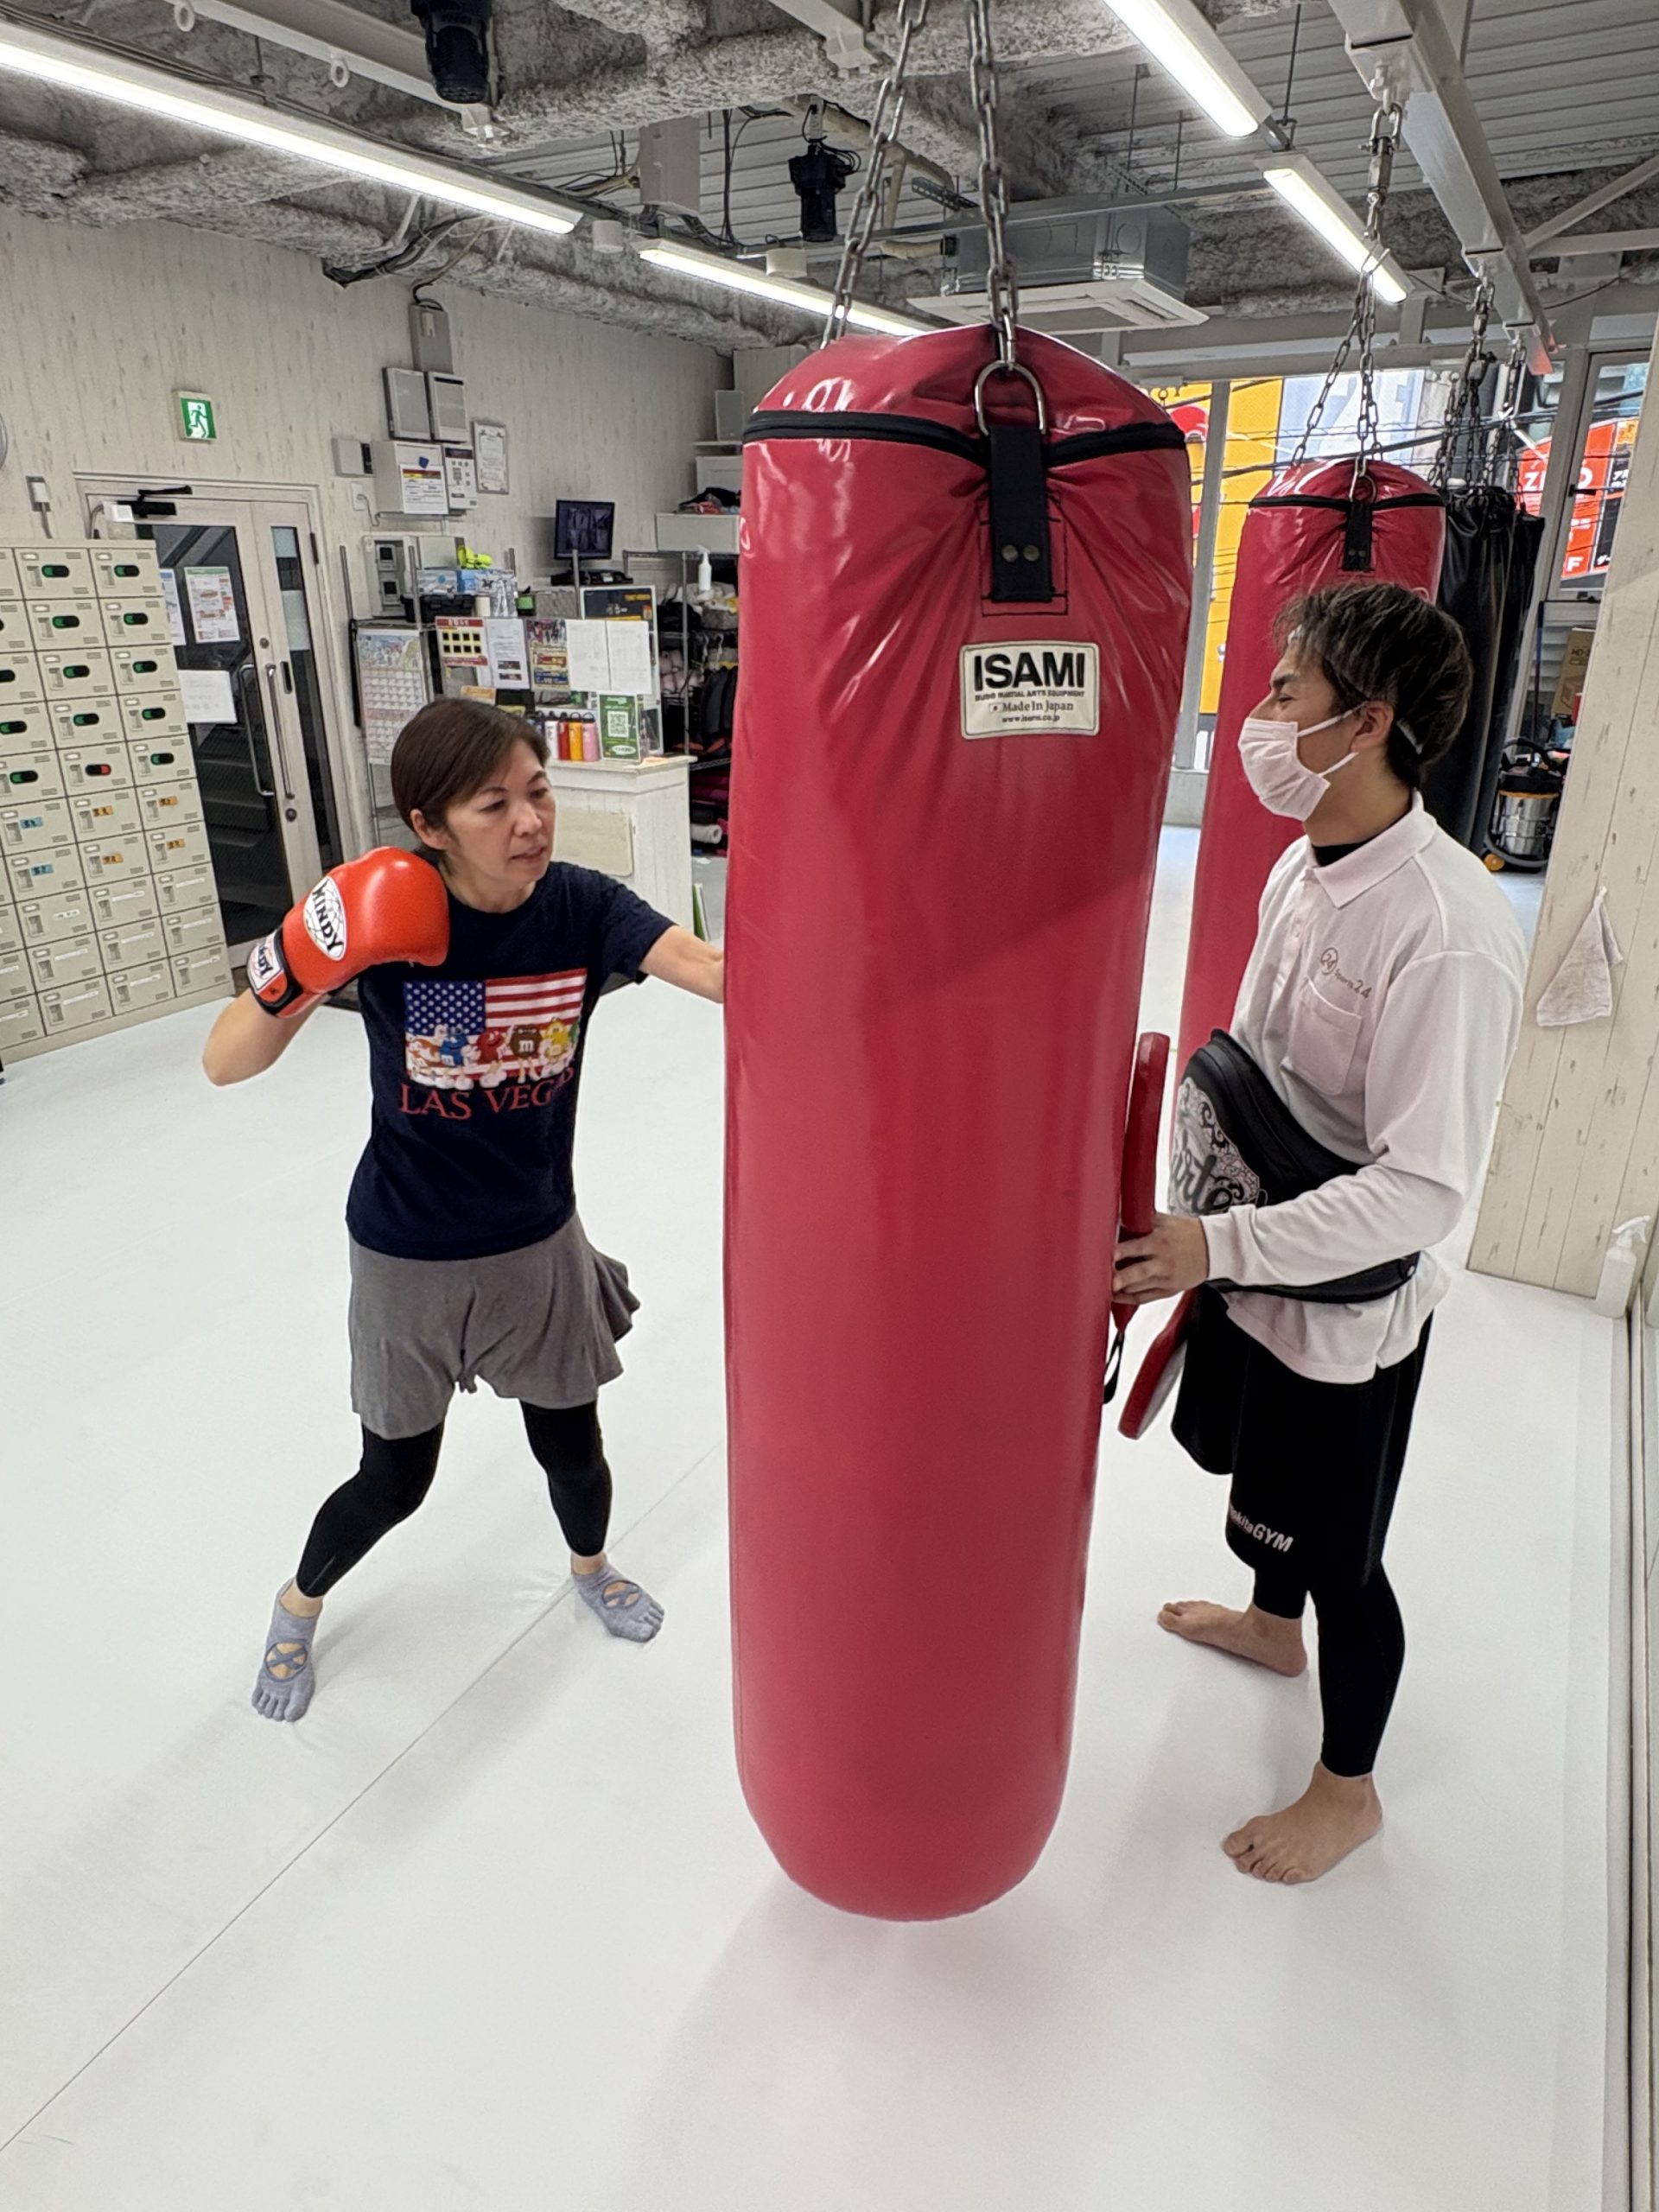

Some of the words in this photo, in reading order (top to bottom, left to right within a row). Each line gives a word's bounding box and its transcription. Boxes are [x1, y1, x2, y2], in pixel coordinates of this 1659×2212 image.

[974, 652, 1085, 691] ISAMI
[997, 690, 1025, 699] MARTIAL
[1002, 700, 1030, 712] Made
[1032, 700, 1043, 710] In
[1045, 699, 1074, 714] Japan
[400, 1083, 473, 1121] LAS
